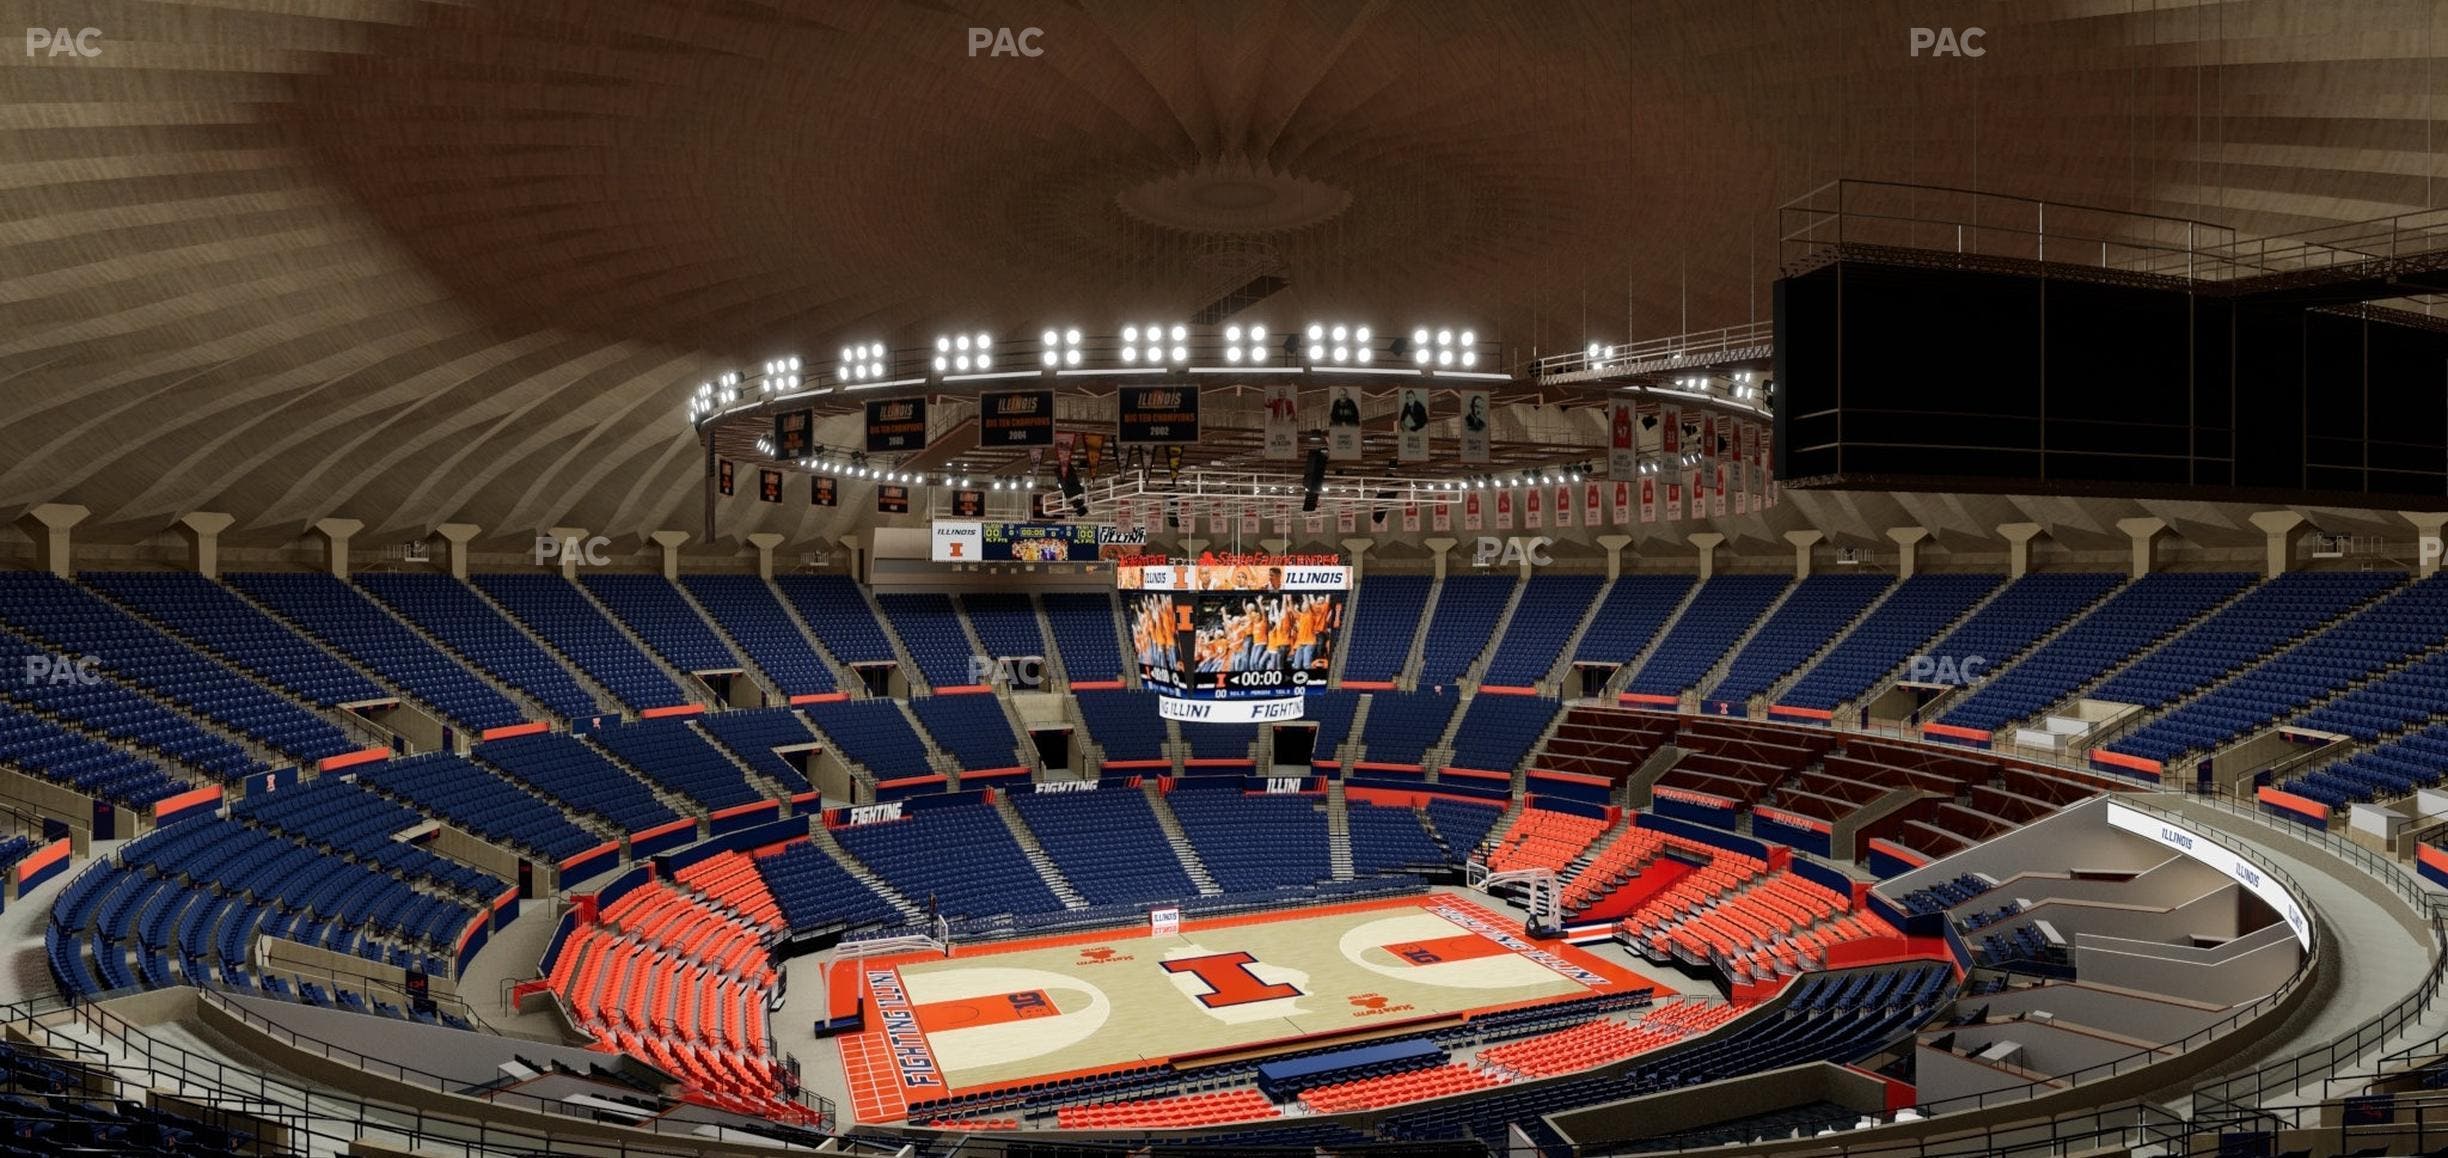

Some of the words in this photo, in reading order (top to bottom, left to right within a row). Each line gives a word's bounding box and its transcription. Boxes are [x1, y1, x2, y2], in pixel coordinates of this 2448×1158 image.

[1285, 572, 1343, 584] ILLINOIS
[1241, 671, 1283, 686] 00:00
[1215, 689, 1227, 699] 00
[1294, 687, 1306, 696] 00
[1169, 704, 1211, 718] ILLINI
[1035, 779, 1099, 794] FIGHTING
[1266, 778, 1302, 793] ILLINI
[850, 802, 903, 826] FIGHTING
[2161, 828, 2193, 850] ILLINOIS
[2236, 862, 2260, 888] ILLINOIS
[866, 969, 908, 1009] ILLINI
[879, 1009, 942, 1087] FIGHTING
